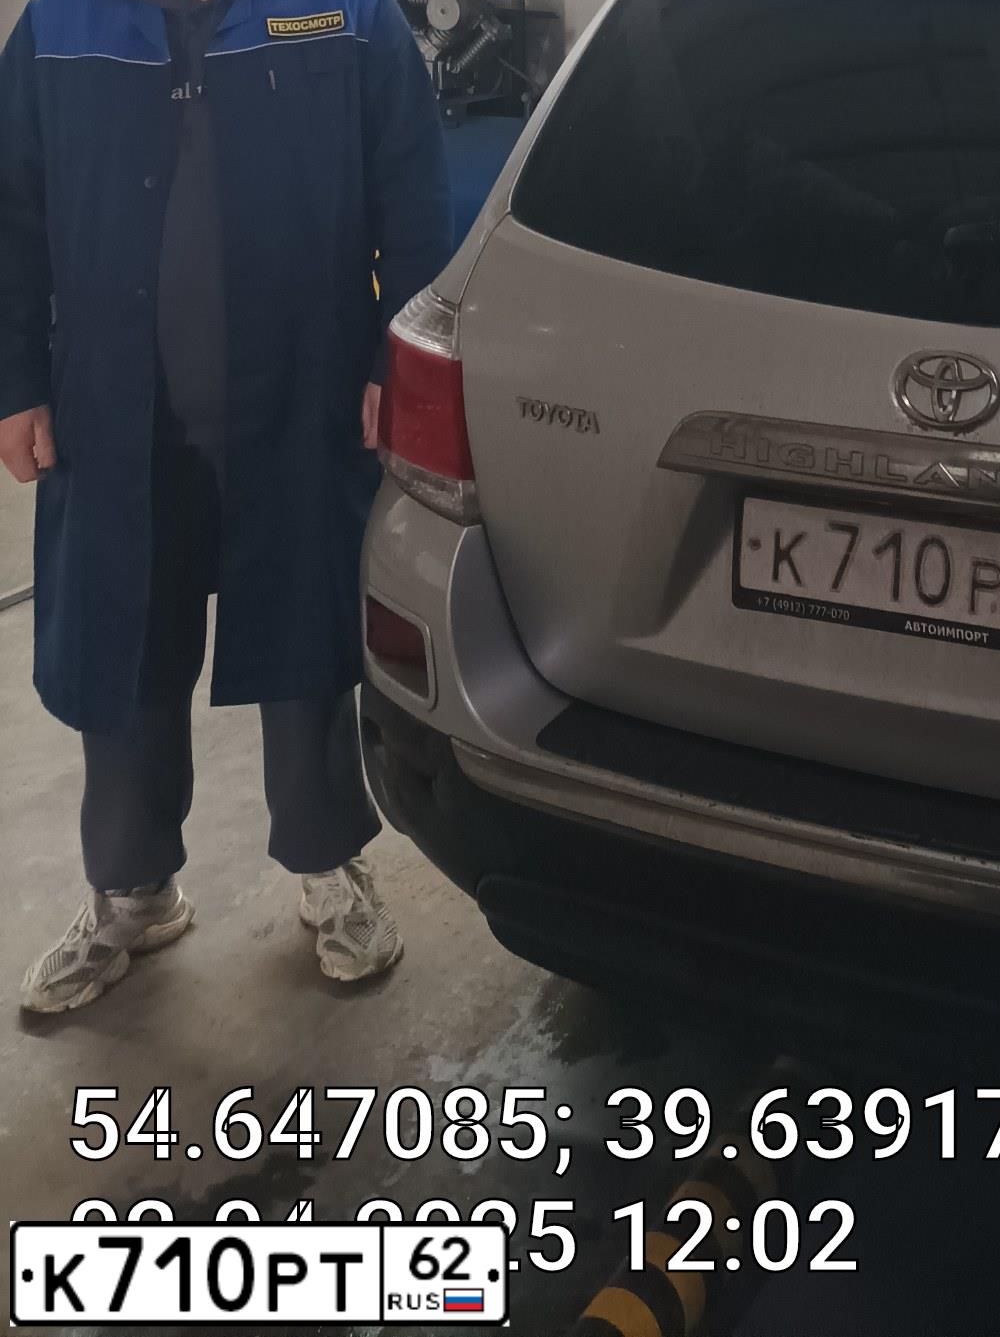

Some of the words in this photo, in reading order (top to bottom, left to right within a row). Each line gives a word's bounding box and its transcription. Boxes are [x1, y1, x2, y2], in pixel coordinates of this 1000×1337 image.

[270, 15, 341, 33] ТЕХОСМОТР
[516, 396, 600, 434] TOYOTA
[904, 620, 989, 644] АВТОИМПОРТ
